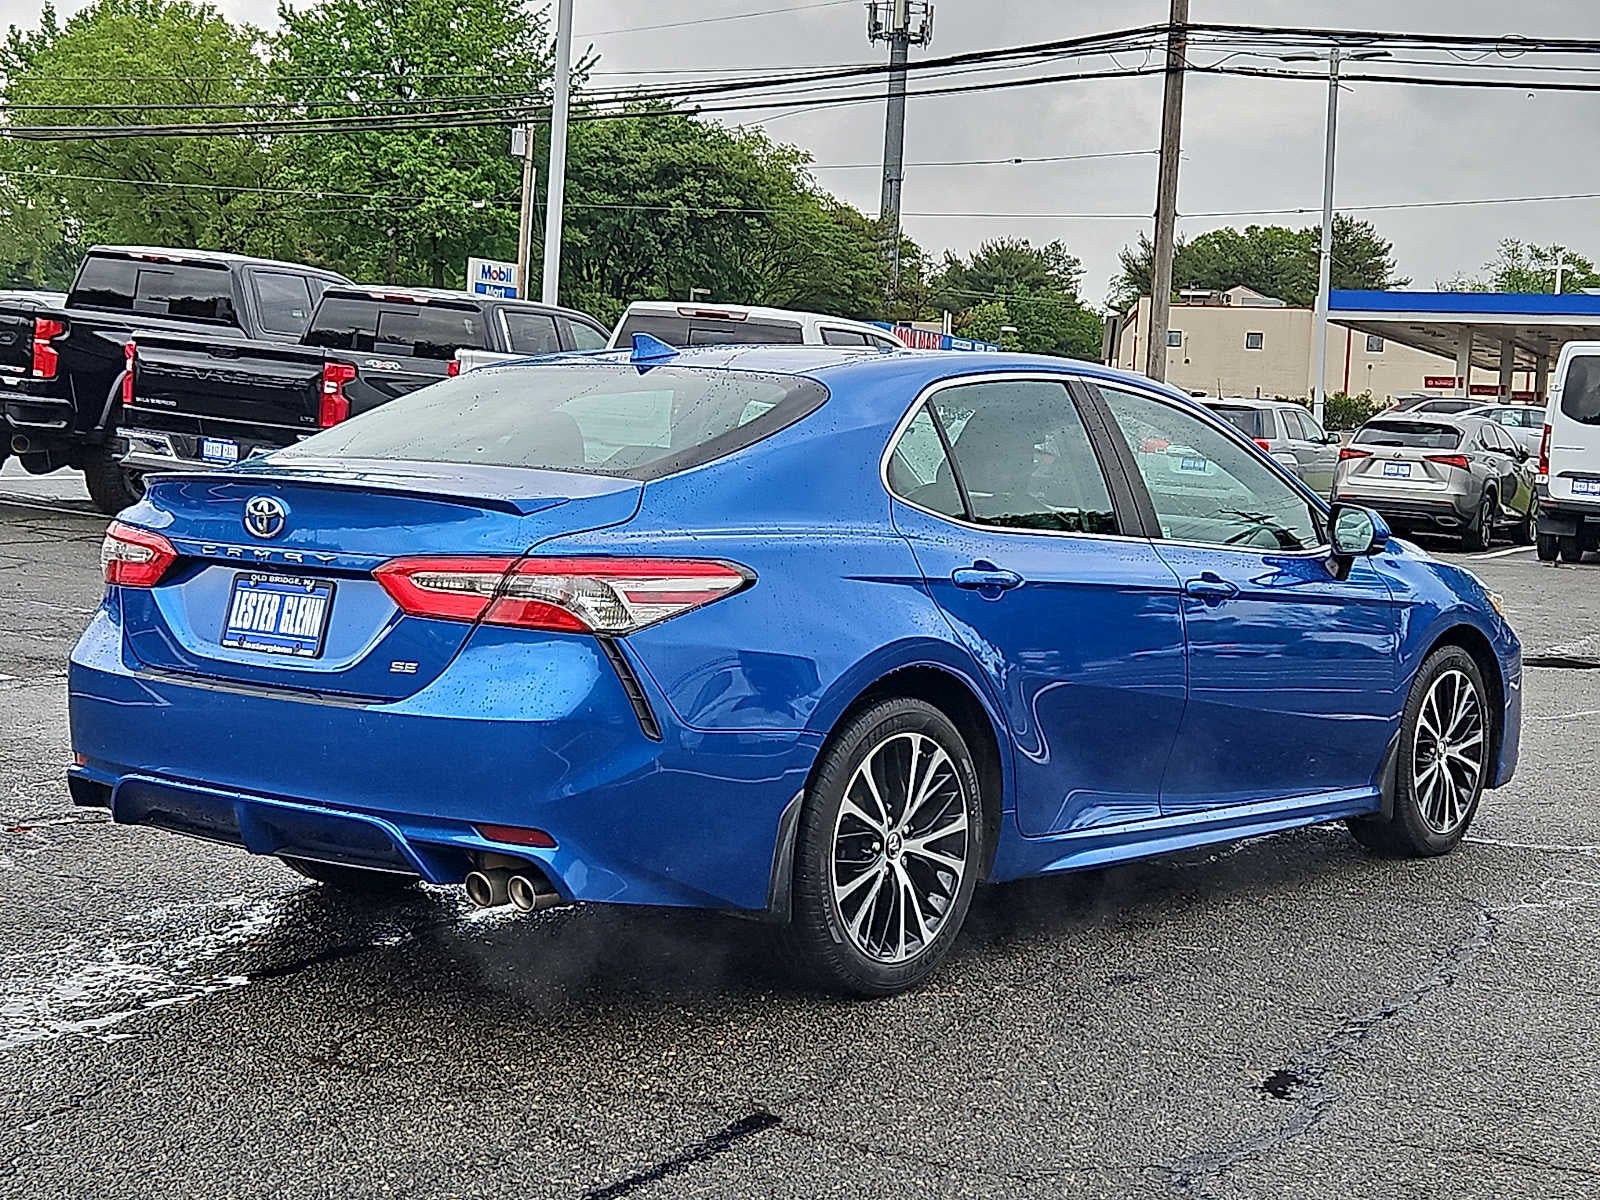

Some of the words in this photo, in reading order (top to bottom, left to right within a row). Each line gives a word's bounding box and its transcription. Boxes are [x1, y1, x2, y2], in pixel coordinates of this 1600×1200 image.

[481, 264, 513, 283] Mobil
[485, 286, 506, 298] Mart
[202, 545, 337, 564] CAMRY
[251, 574, 268, 582] OLD
[228, 590, 281, 632] LESTER
[279, 595, 326, 637] GLENN
[389, 661, 419, 674] SE
